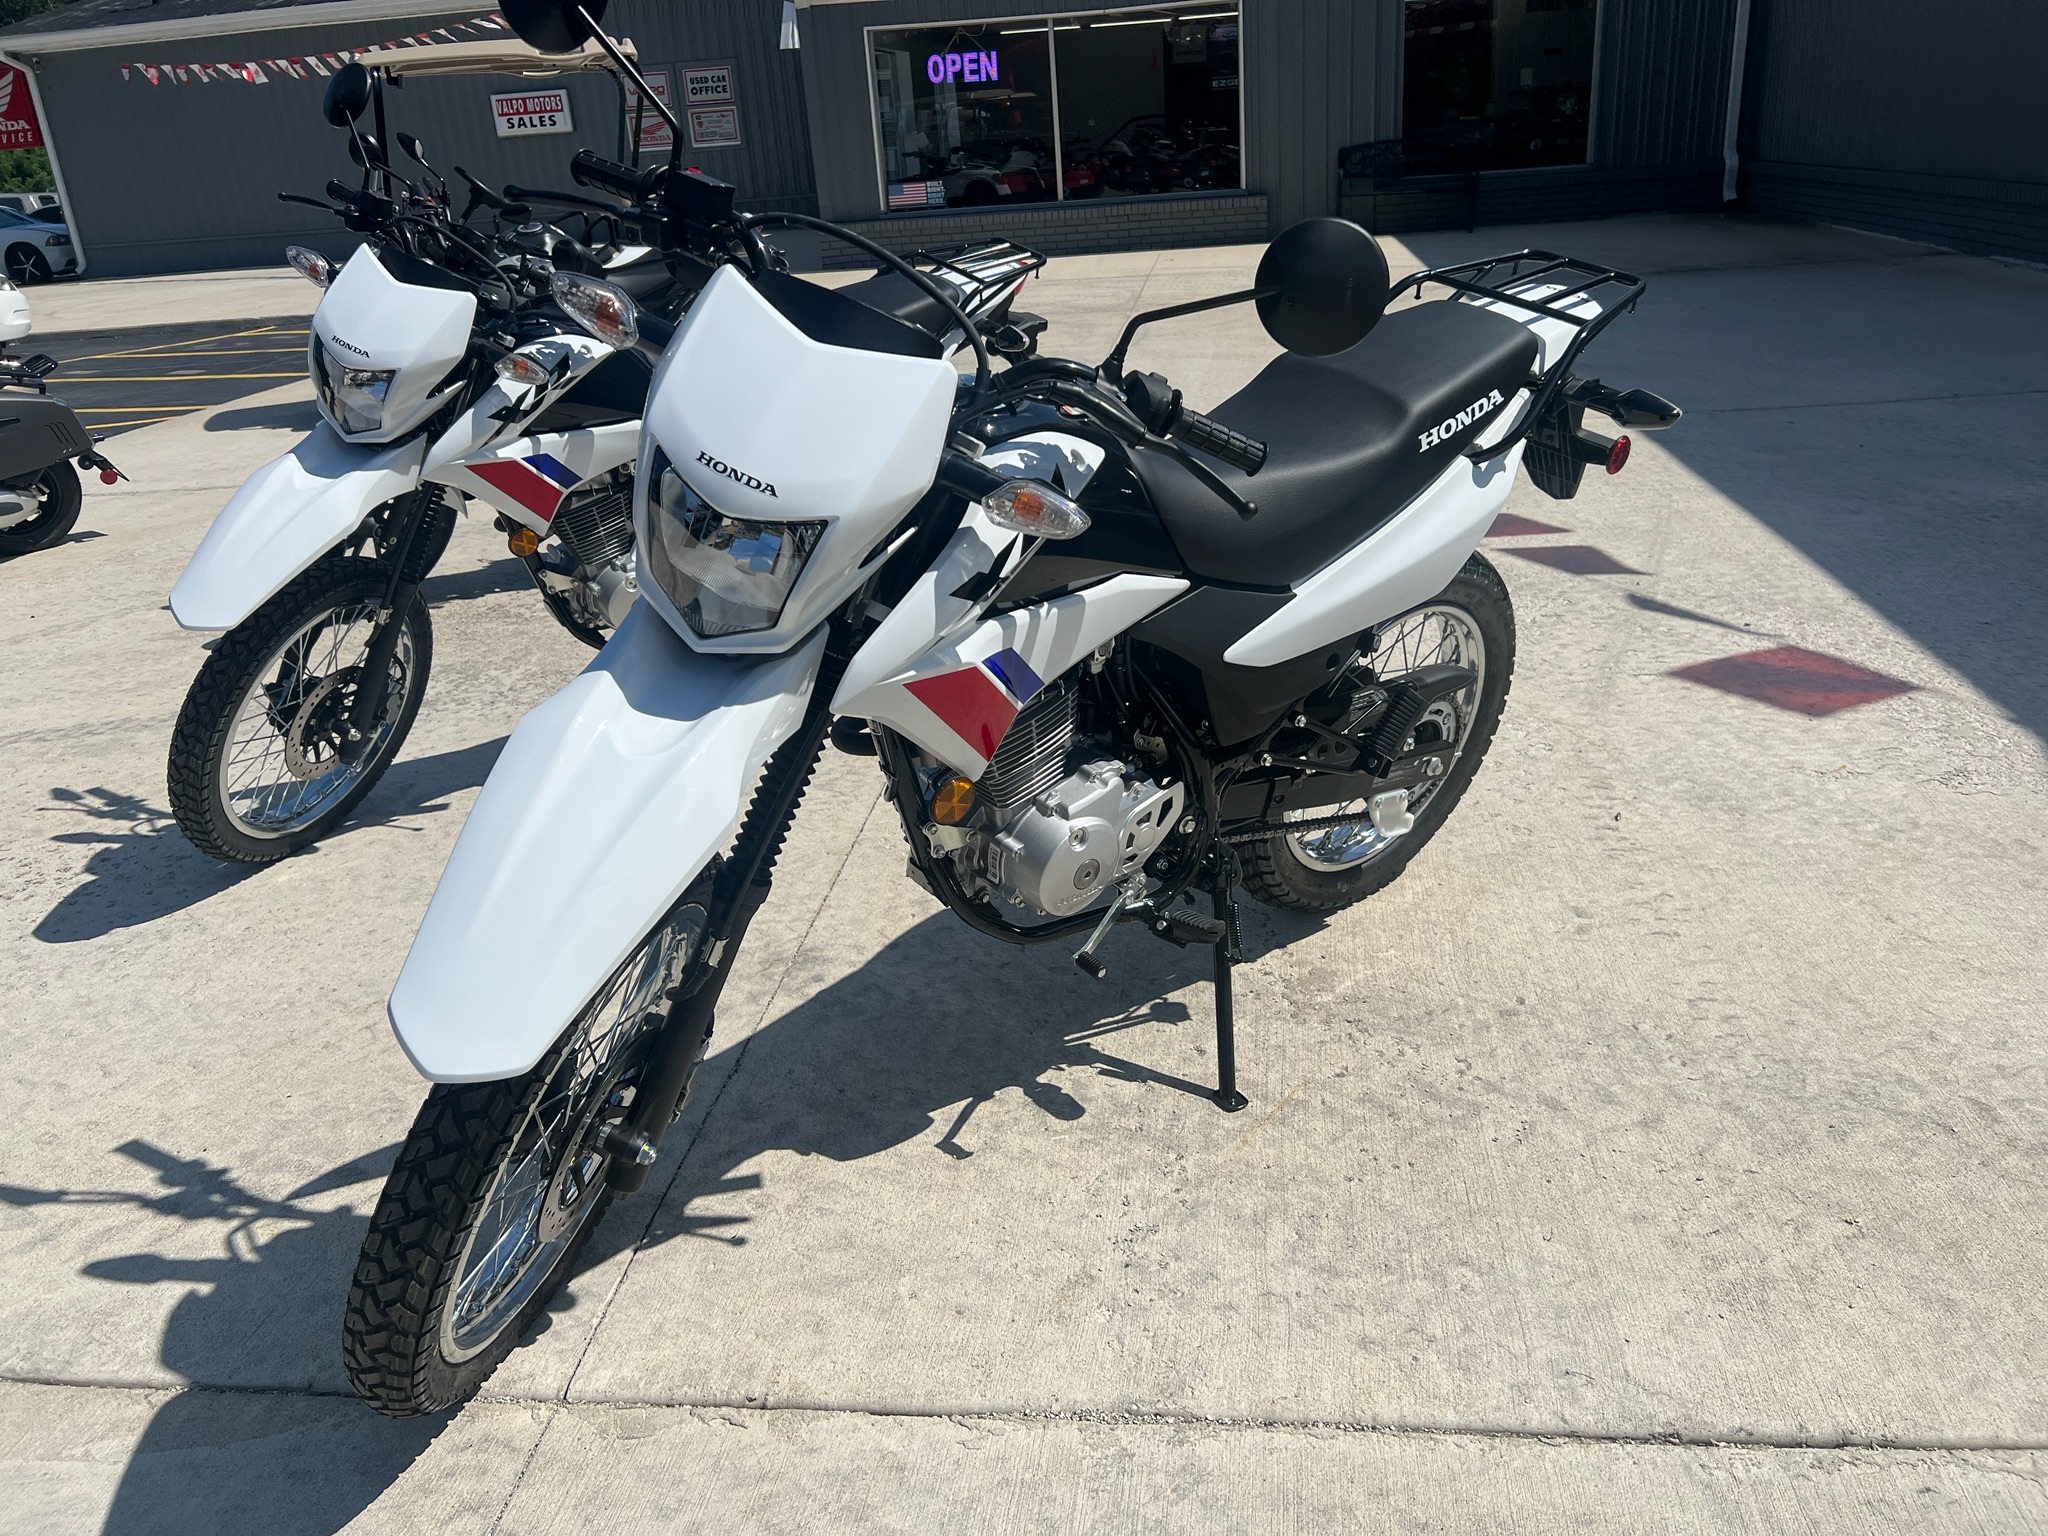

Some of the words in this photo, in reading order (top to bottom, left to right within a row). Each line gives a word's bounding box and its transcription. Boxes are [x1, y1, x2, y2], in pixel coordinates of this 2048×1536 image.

[927, 50, 998, 84] OPEN
[689, 76, 709, 85] USED
[711, 75, 727, 83] CAR
[690, 84, 729, 96] OFFICE
[495, 99, 524, 115] VALPO
[526, 96, 562, 112] MOTORS
[0, 119, 31, 131] NDA
[506, 114, 557, 130] SALES
[331, 335, 371, 359] HONDA
[1417, 388, 1505, 453] HONDA
[695, 450, 779, 498] HONDA
